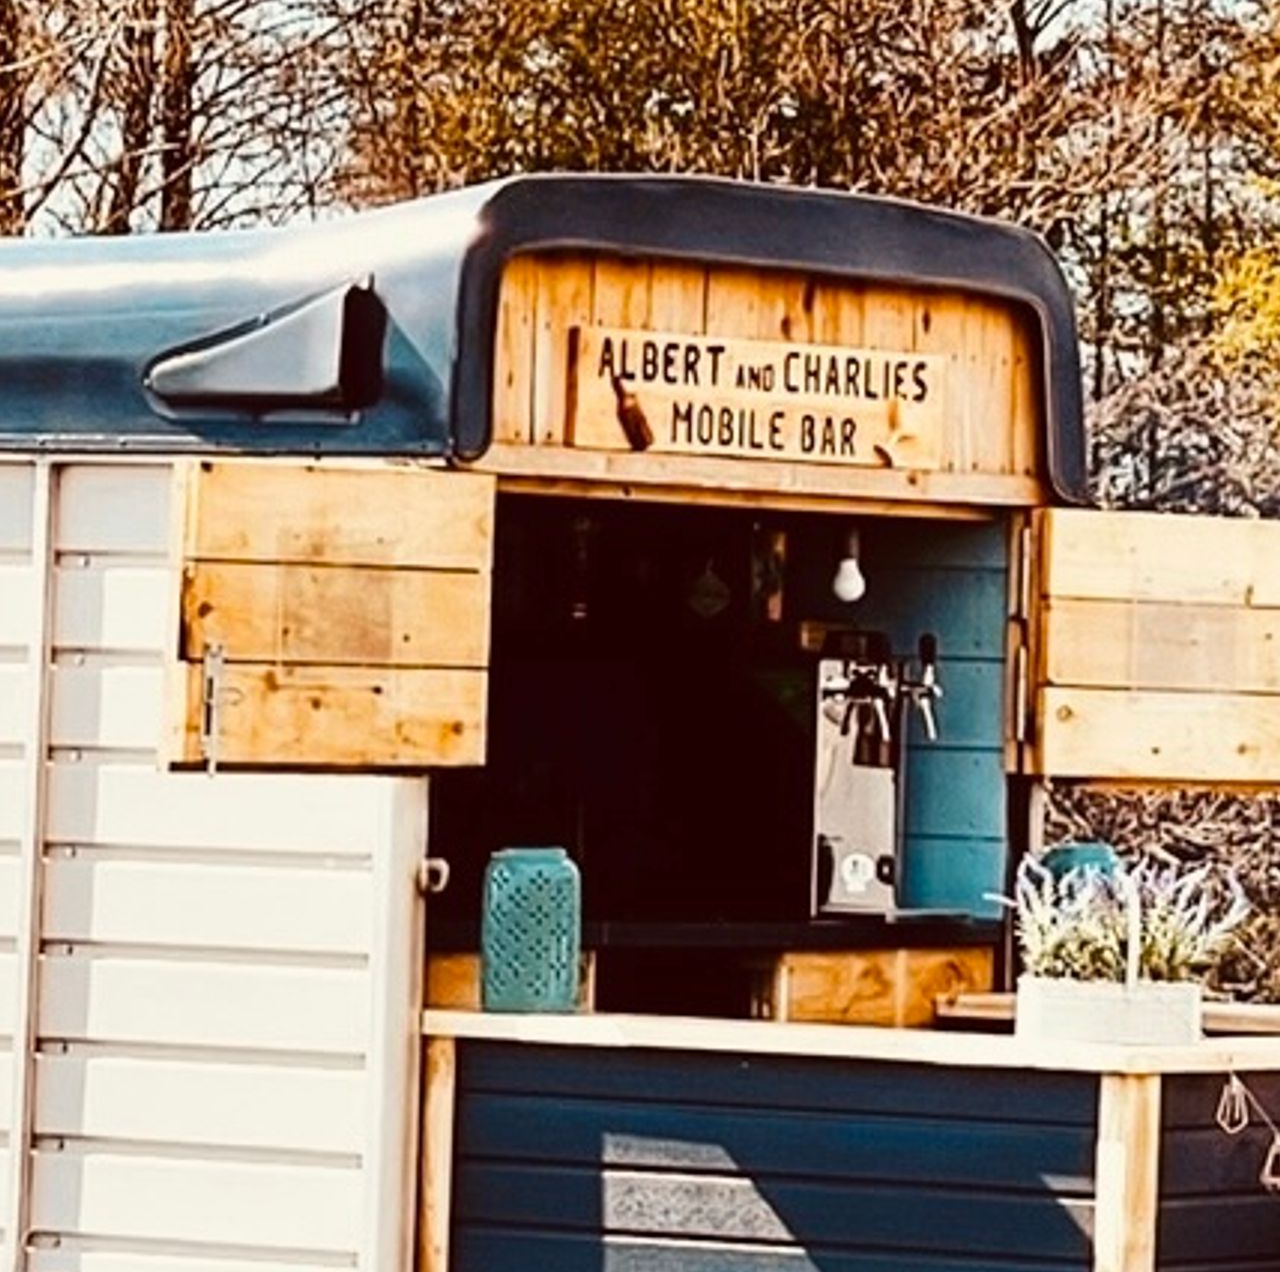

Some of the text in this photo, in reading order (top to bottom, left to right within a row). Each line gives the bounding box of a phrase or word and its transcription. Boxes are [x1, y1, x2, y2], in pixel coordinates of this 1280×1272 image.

[598, 336, 928, 402] ALBERT AND CHARLIES
[672, 400, 857, 456] MOBILE BAR
